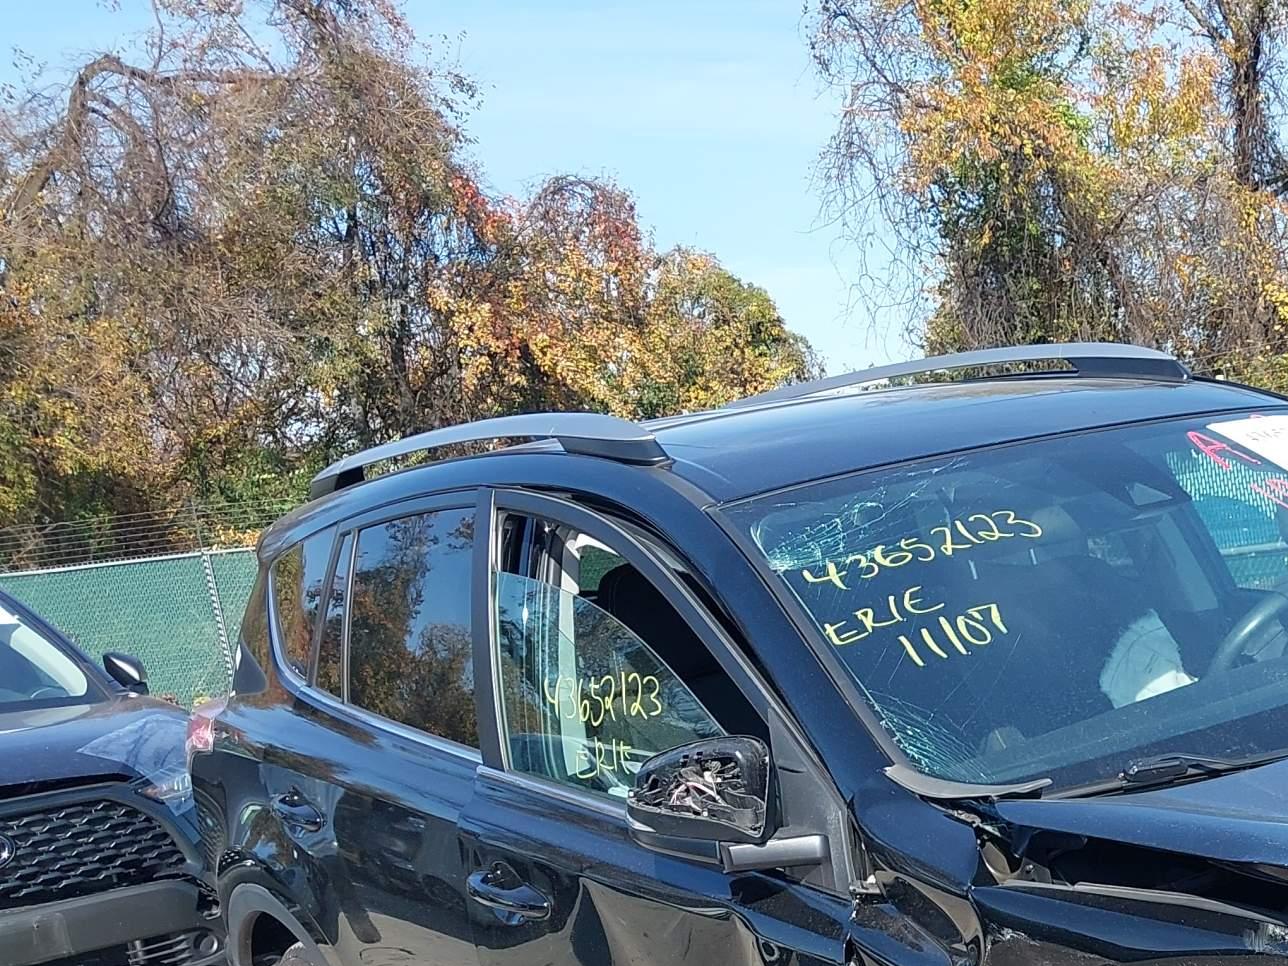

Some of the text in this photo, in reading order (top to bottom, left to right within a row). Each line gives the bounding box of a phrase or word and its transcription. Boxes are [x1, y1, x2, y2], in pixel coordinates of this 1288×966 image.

[802, 510, 1042, 590] 43652123
[824, 586, 945, 646] ERIE
[544, 671, 662, 727] 43652123
